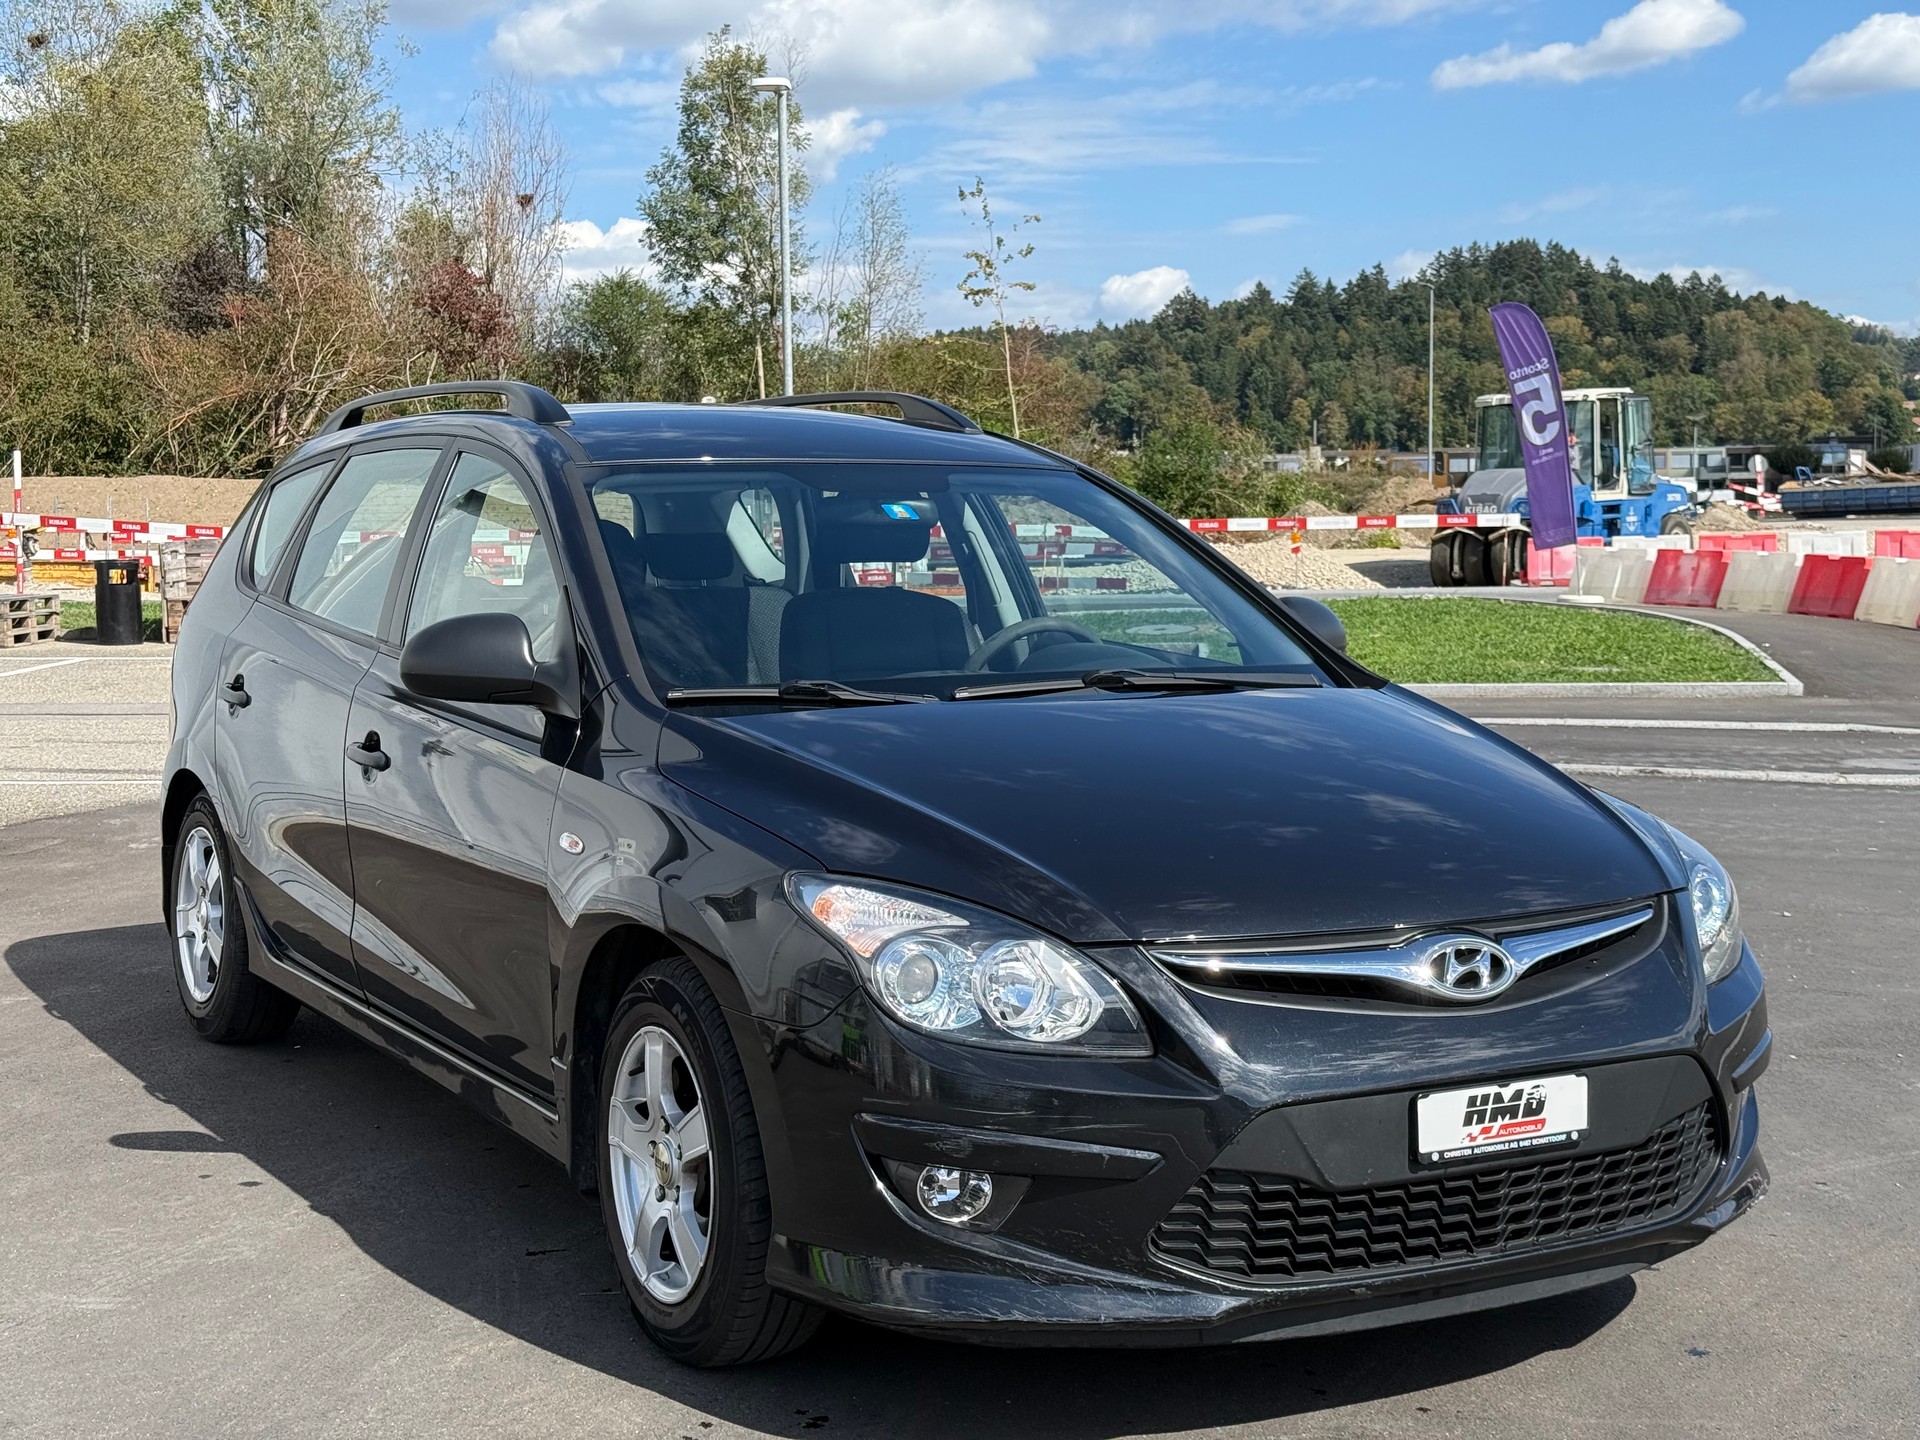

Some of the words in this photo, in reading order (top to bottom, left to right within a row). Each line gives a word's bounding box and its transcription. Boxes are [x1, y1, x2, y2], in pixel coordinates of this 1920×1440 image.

[1464, 505, 1498, 514] KIBAG
[48, 518, 69, 527] KIBAG
[121, 523, 142, 531] KIBAG
[1198, 521, 1219, 530] KIBAG
[1366, 518, 1388, 527] KIBAG
[194, 527, 216, 536] KIBAG
[60, 550, 79, 558] KIBAG
[1498, 1123, 1543, 1136] AUTOMOBILE
[1443, 1148, 1472, 1159] CHRISTEN
[1473, 1142, 1509, 1154] AUTOMOBILE
[1509, 1141, 1518, 1149] AG
